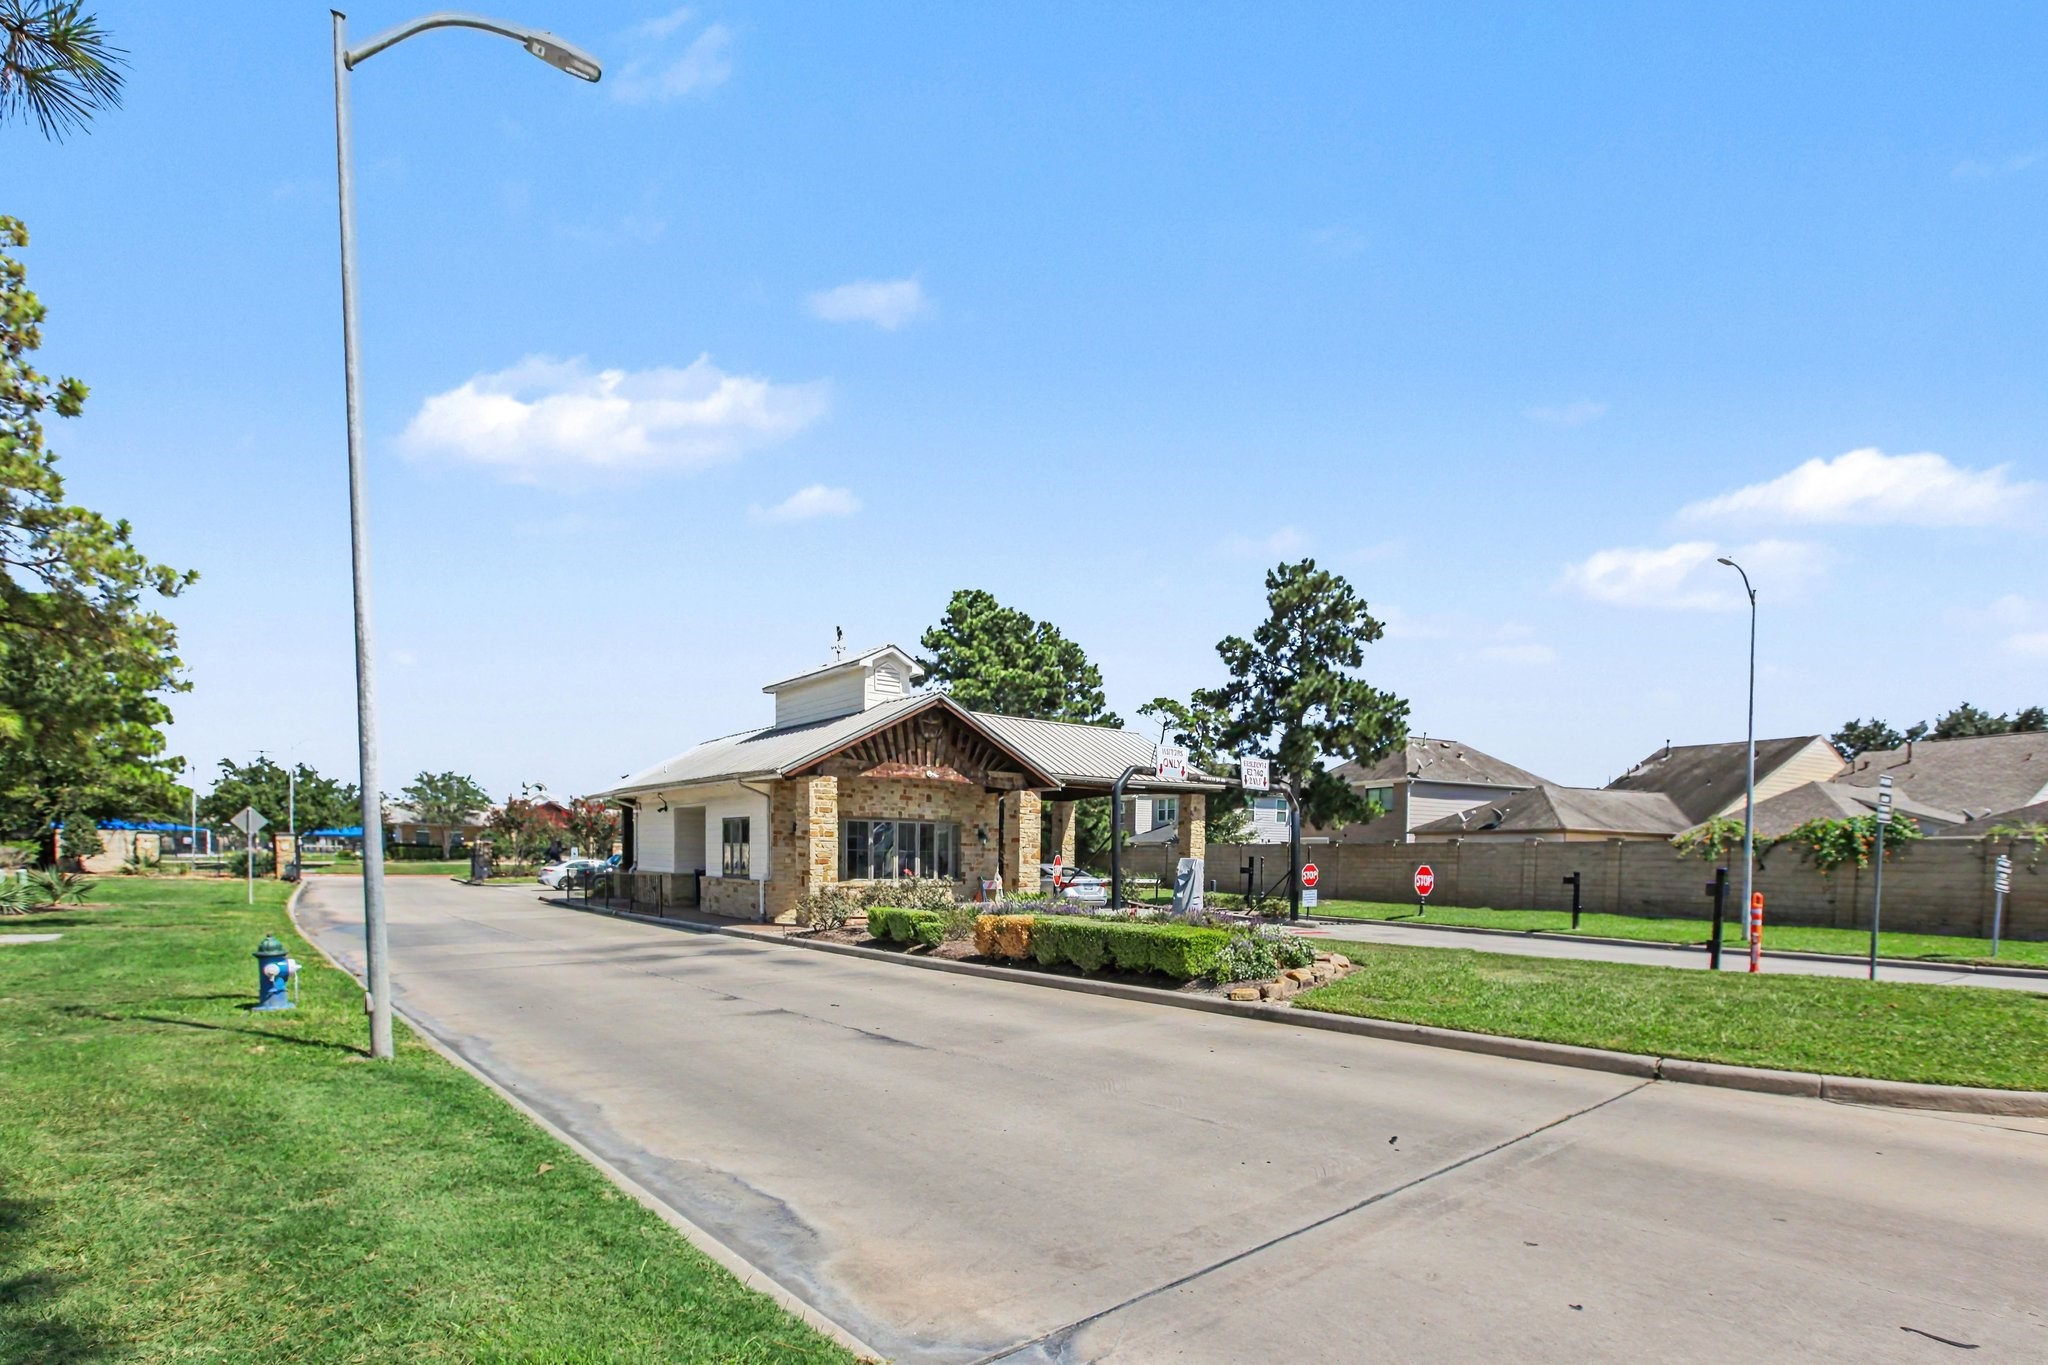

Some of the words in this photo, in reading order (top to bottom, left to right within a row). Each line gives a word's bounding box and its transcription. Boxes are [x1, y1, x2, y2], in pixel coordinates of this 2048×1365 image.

[1163, 758, 1182, 768] ONLY
[1303, 871, 1317, 879] STOP
[1416, 875, 1433, 886] STOP
